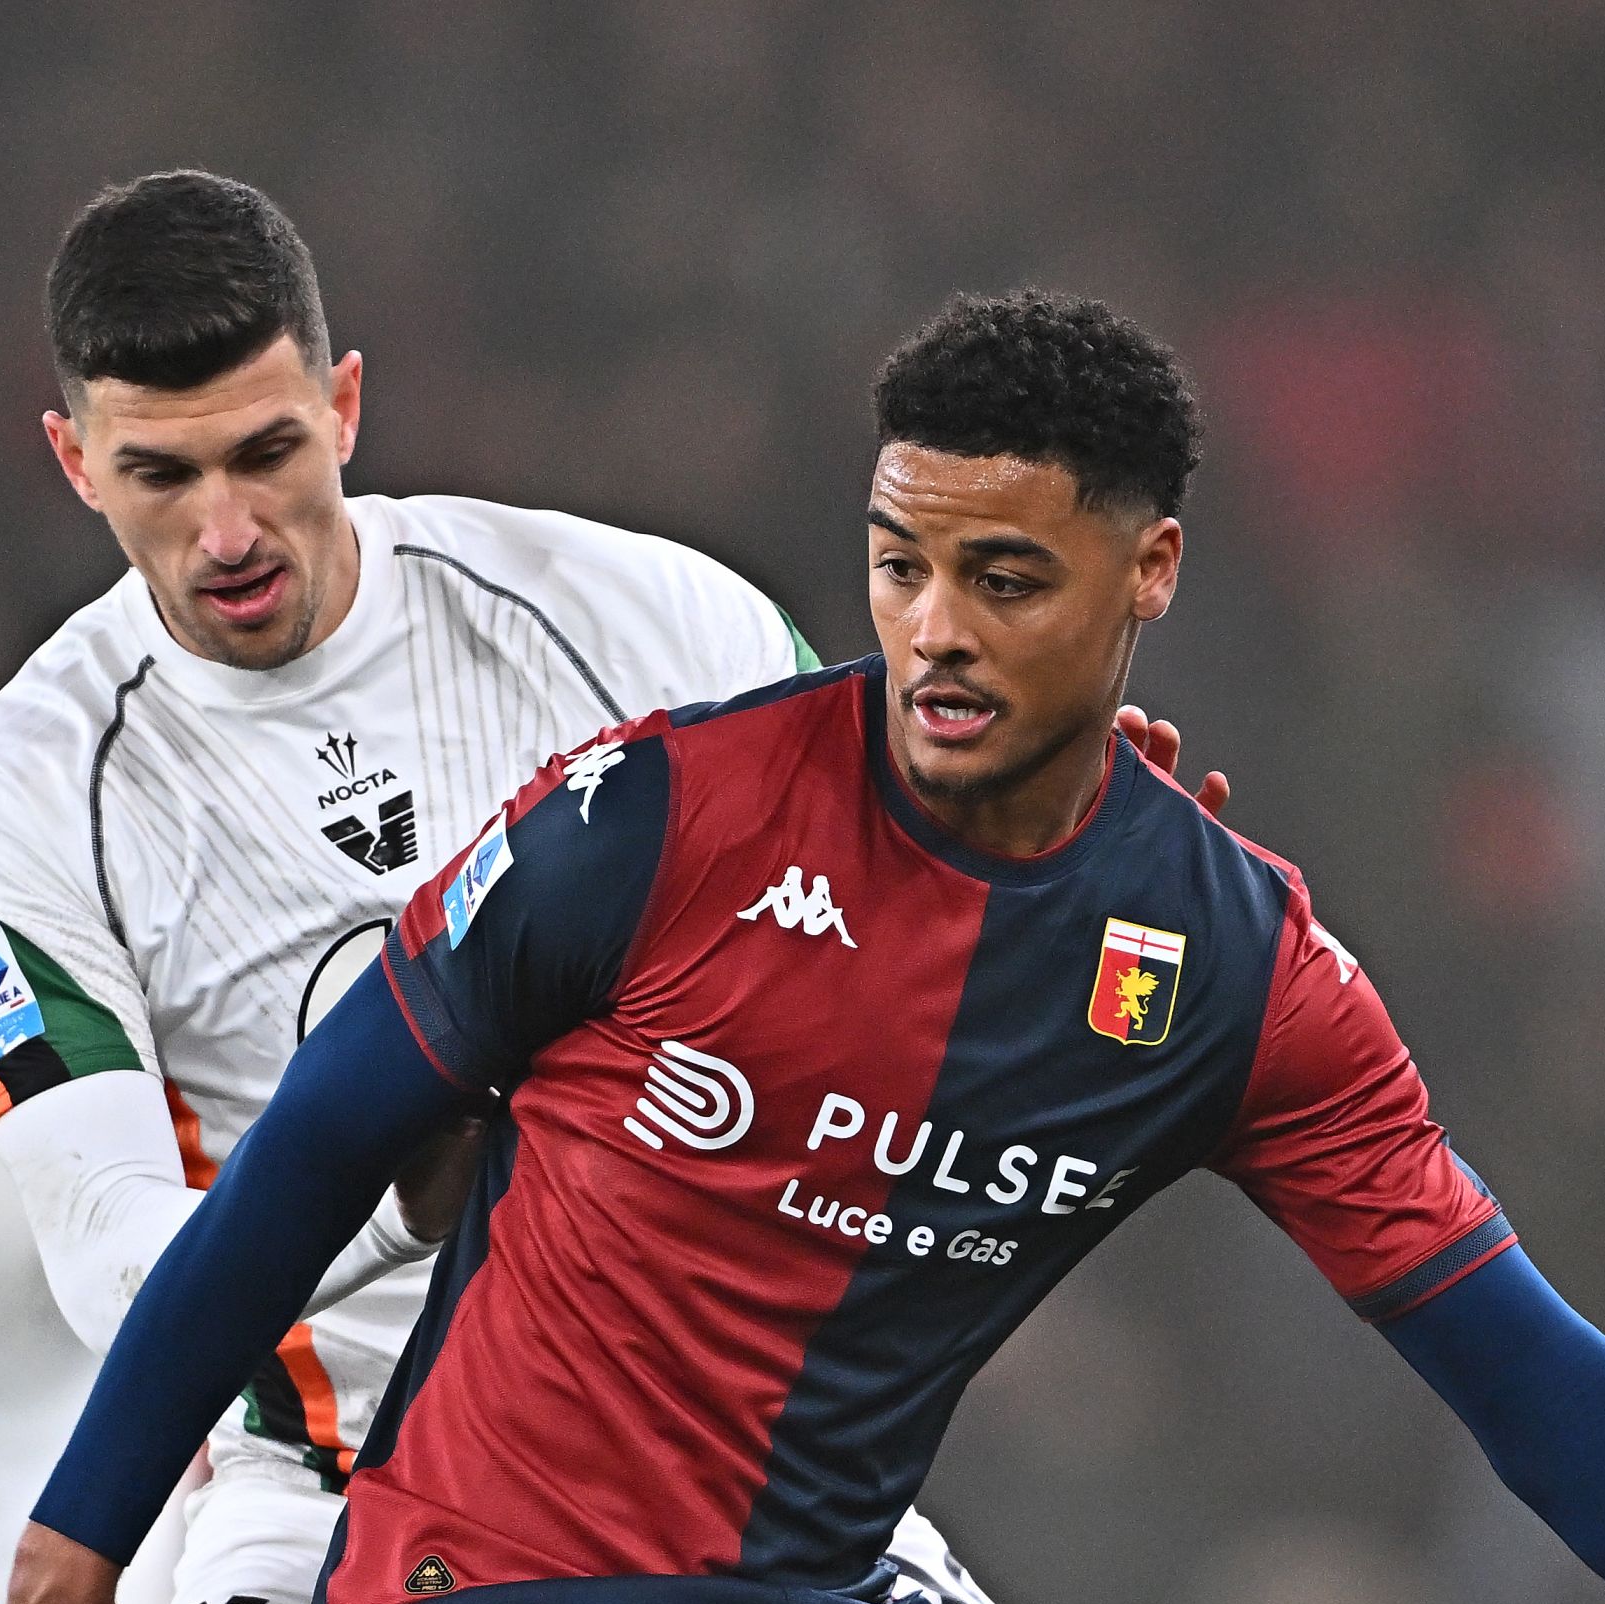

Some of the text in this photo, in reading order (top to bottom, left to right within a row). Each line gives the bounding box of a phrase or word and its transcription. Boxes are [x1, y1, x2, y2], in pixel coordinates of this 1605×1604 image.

[317, 768, 398, 810] NOCTA
[13, 985, 23, 998] A
[777, 1178, 1019, 1266] Luce e Gas
